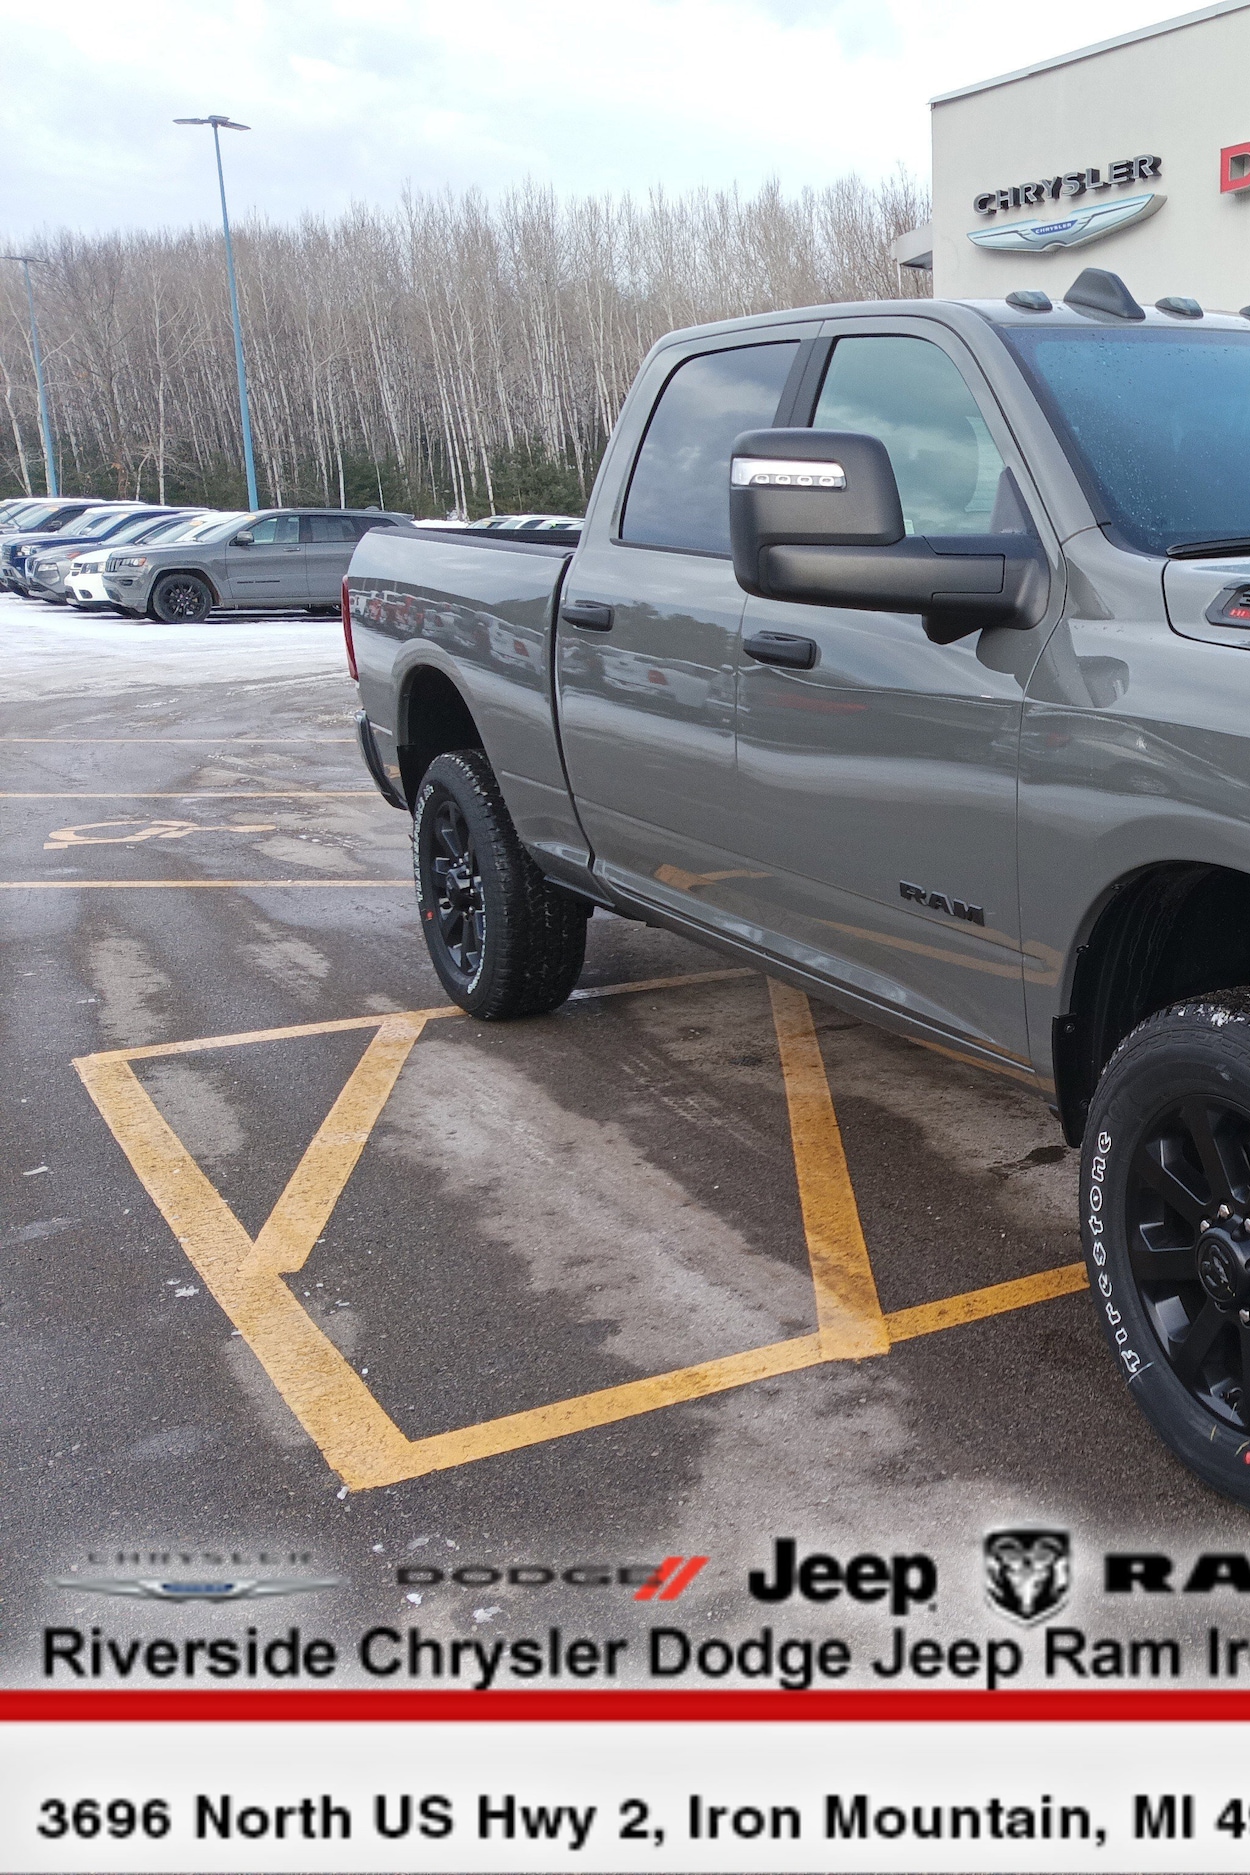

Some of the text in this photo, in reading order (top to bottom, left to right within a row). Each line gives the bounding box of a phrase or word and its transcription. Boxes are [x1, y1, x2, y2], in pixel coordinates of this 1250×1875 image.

[973, 153, 1162, 215] CHRYSLER
[1035, 222, 1072, 234] CHRYSLER
[899, 879, 985, 927] RAM
